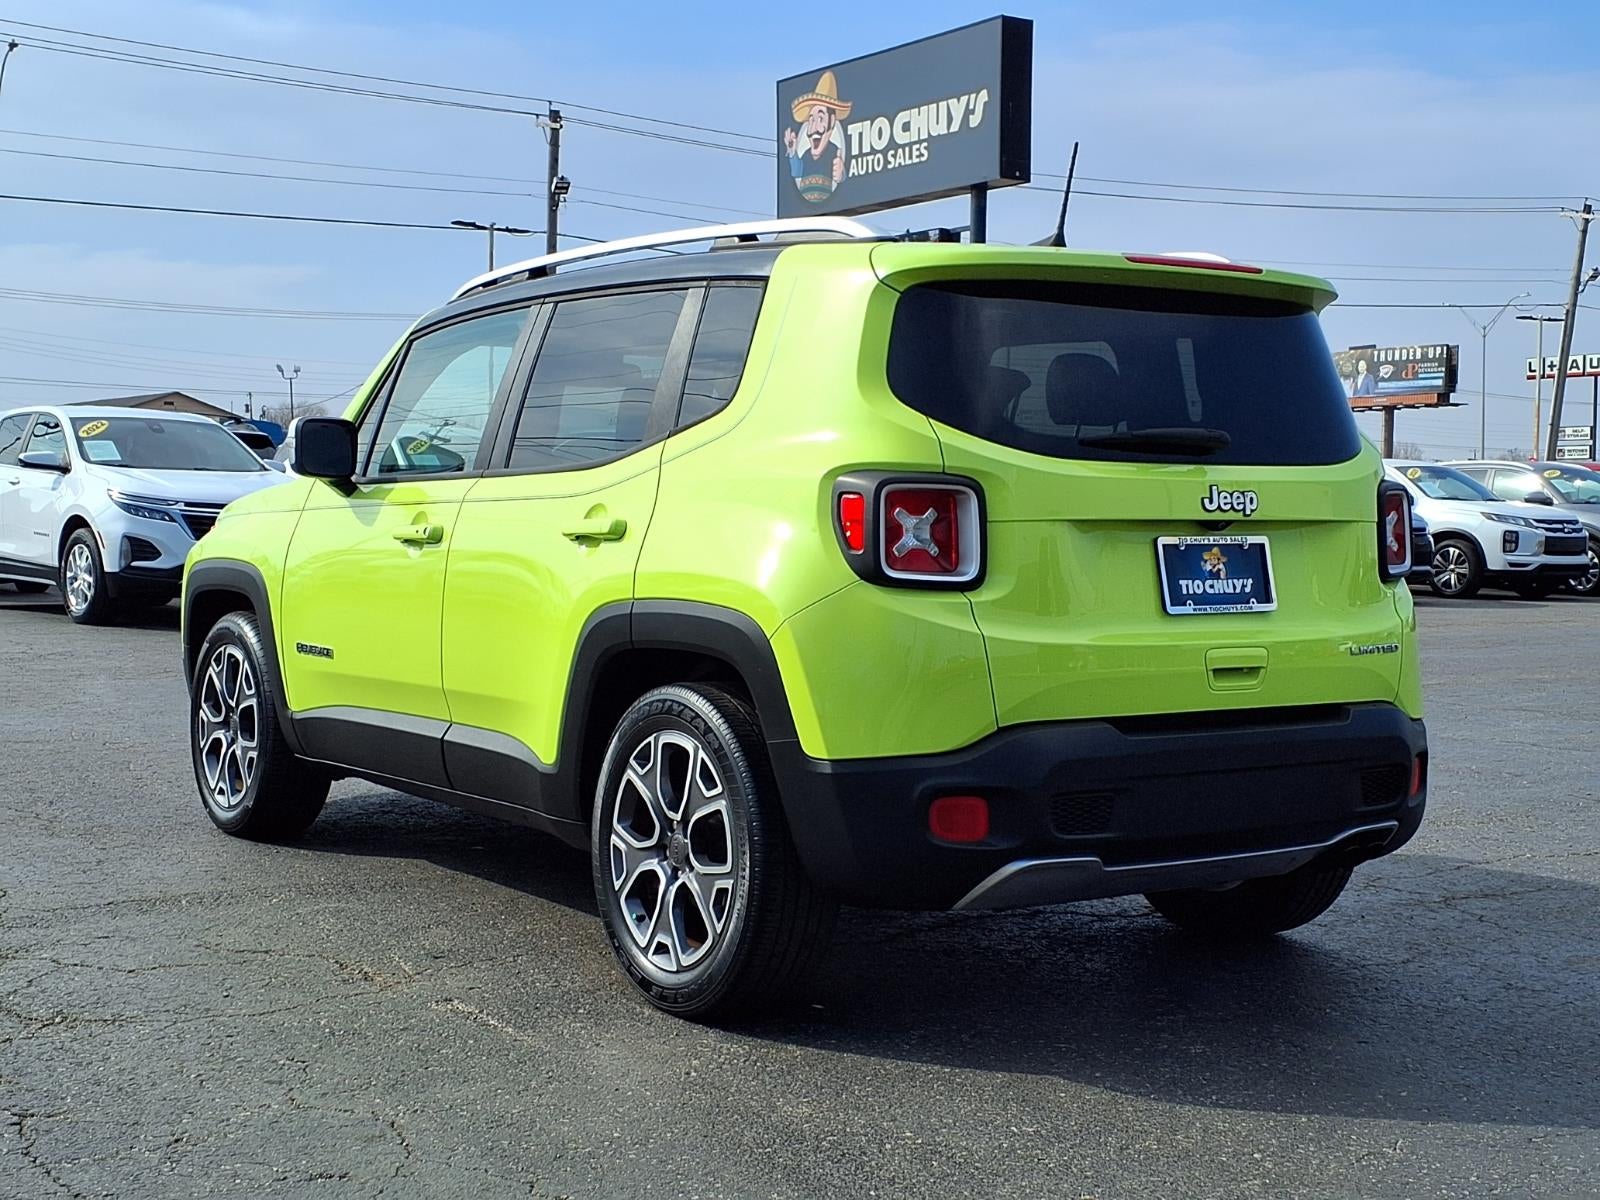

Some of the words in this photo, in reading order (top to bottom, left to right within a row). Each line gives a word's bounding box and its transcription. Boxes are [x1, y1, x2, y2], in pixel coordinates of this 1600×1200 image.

[848, 116, 891, 156] TIO
[893, 88, 989, 145] CHUY'S
[849, 154, 884, 177] AUTO
[887, 142, 928, 169] SALES
[1373, 347, 1422, 362] THUNDER
[1428, 346, 1447, 359] UP!
[1202, 484, 1259, 516] Jeep
[1179, 579, 1204, 595] TIO
[1204, 578, 1254, 594] CHUY'S
[1192, 605, 1254, 613] WWW.TIOCHUYS.COM
[1350, 644, 1398, 656] LIMITED
